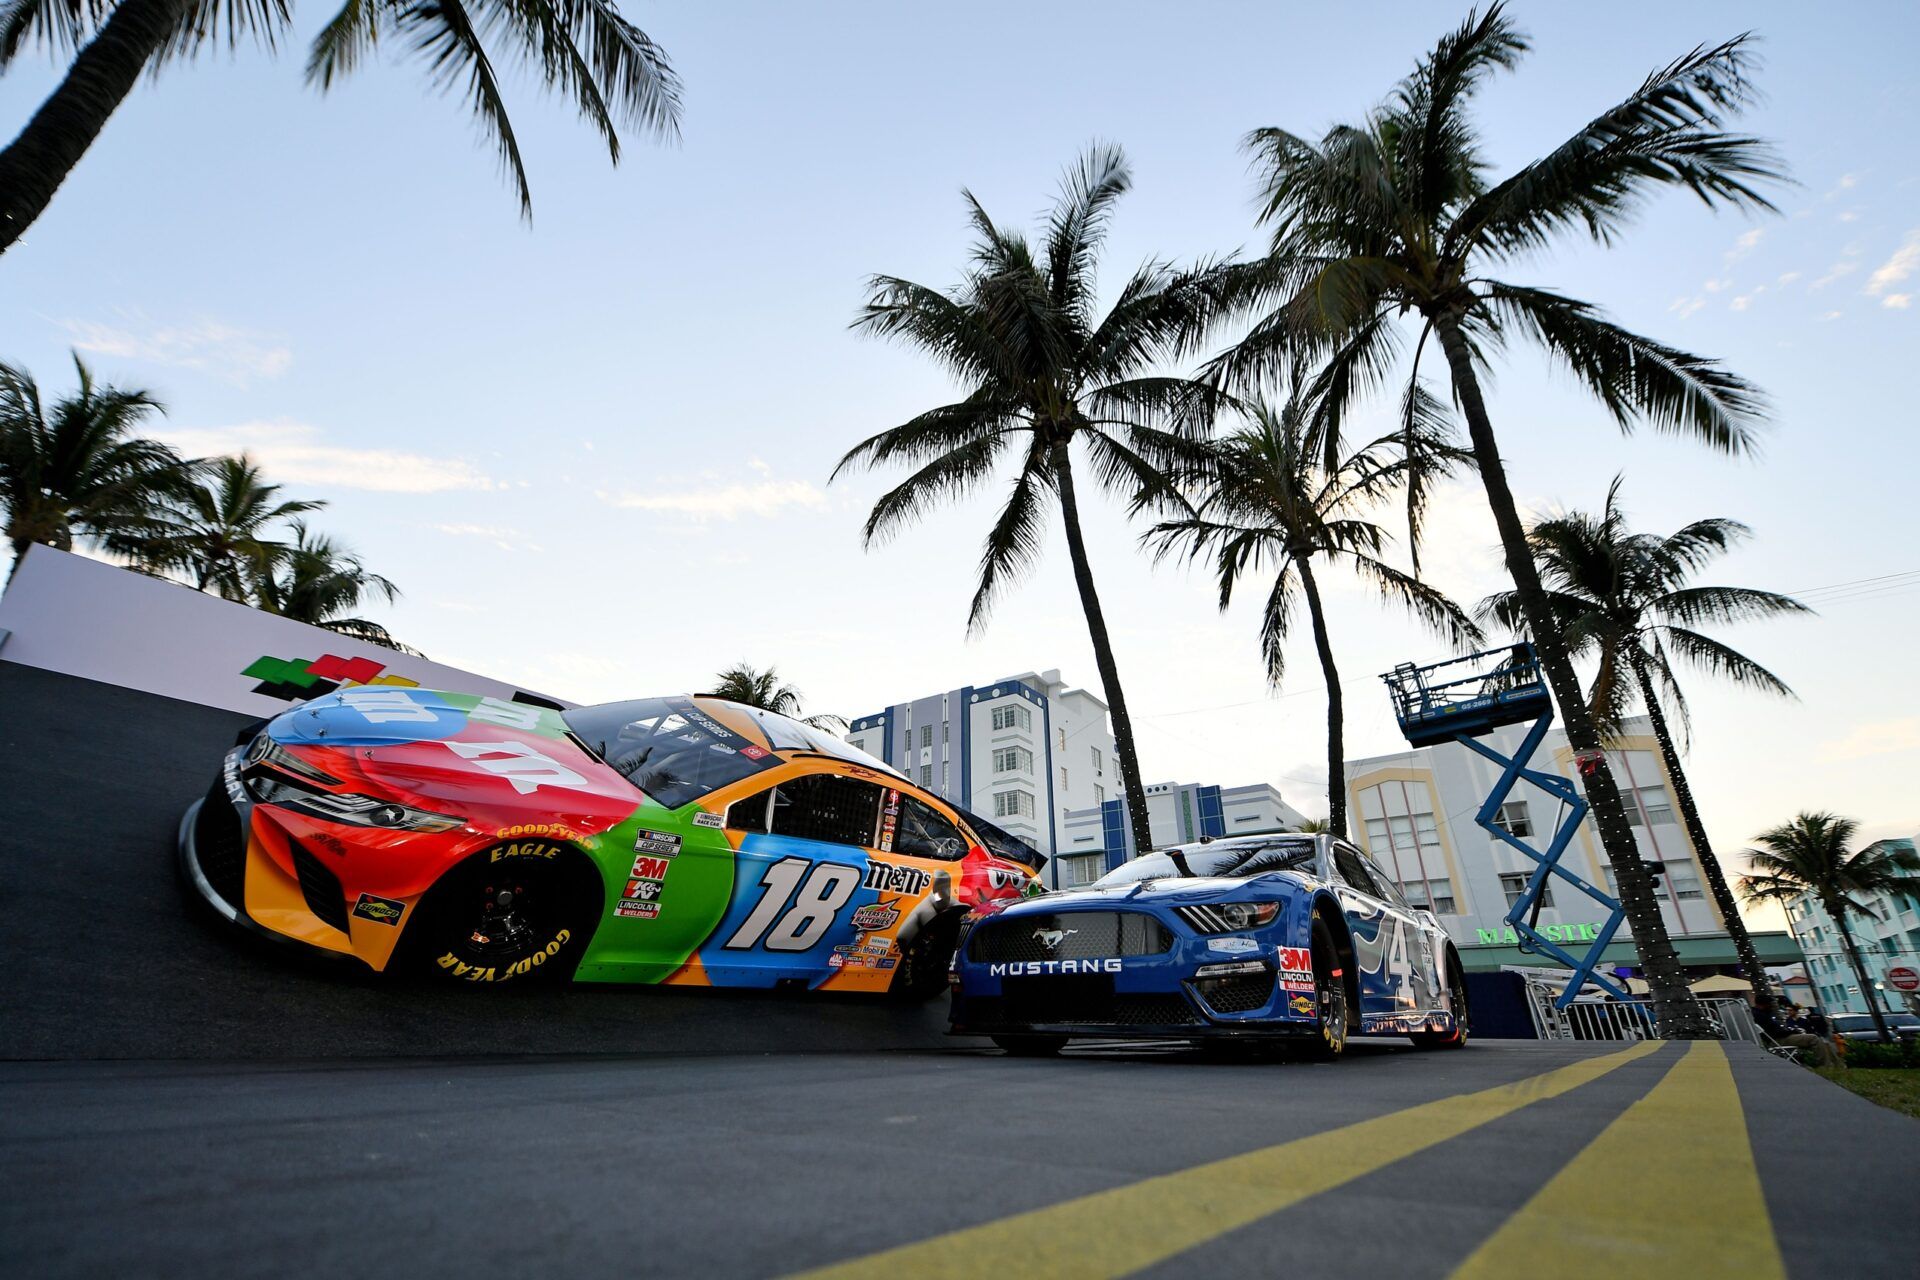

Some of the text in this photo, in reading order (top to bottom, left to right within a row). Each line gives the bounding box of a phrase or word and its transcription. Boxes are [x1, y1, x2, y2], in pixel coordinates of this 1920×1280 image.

[224, 752, 248, 803] CAMRY
[652, 832, 677, 843] NASCAR
[490, 843, 561, 863] EAGLE
[654, 843, 675, 853] SERIES
[632, 857, 669, 880] 3M
[358, 902, 400, 918] SUNOCO
[619, 901, 654, 911] LINCOLN
[721, 854, 862, 954] 18
[623, 909, 654, 918] WELDERS
[856, 916, 890, 926] BATTERIES
[859, 909, 895, 919] INTERSTATE
[1476, 922, 1602, 945] MASTIC
[436, 929, 571, 982] GOODYEAR
[1280, 948, 1312, 972] 3M
[1387, 917, 1418, 1009] 4
[990, 958, 1122, 976] MUSTANG
[1280, 972, 1312, 982] LINCOLN
